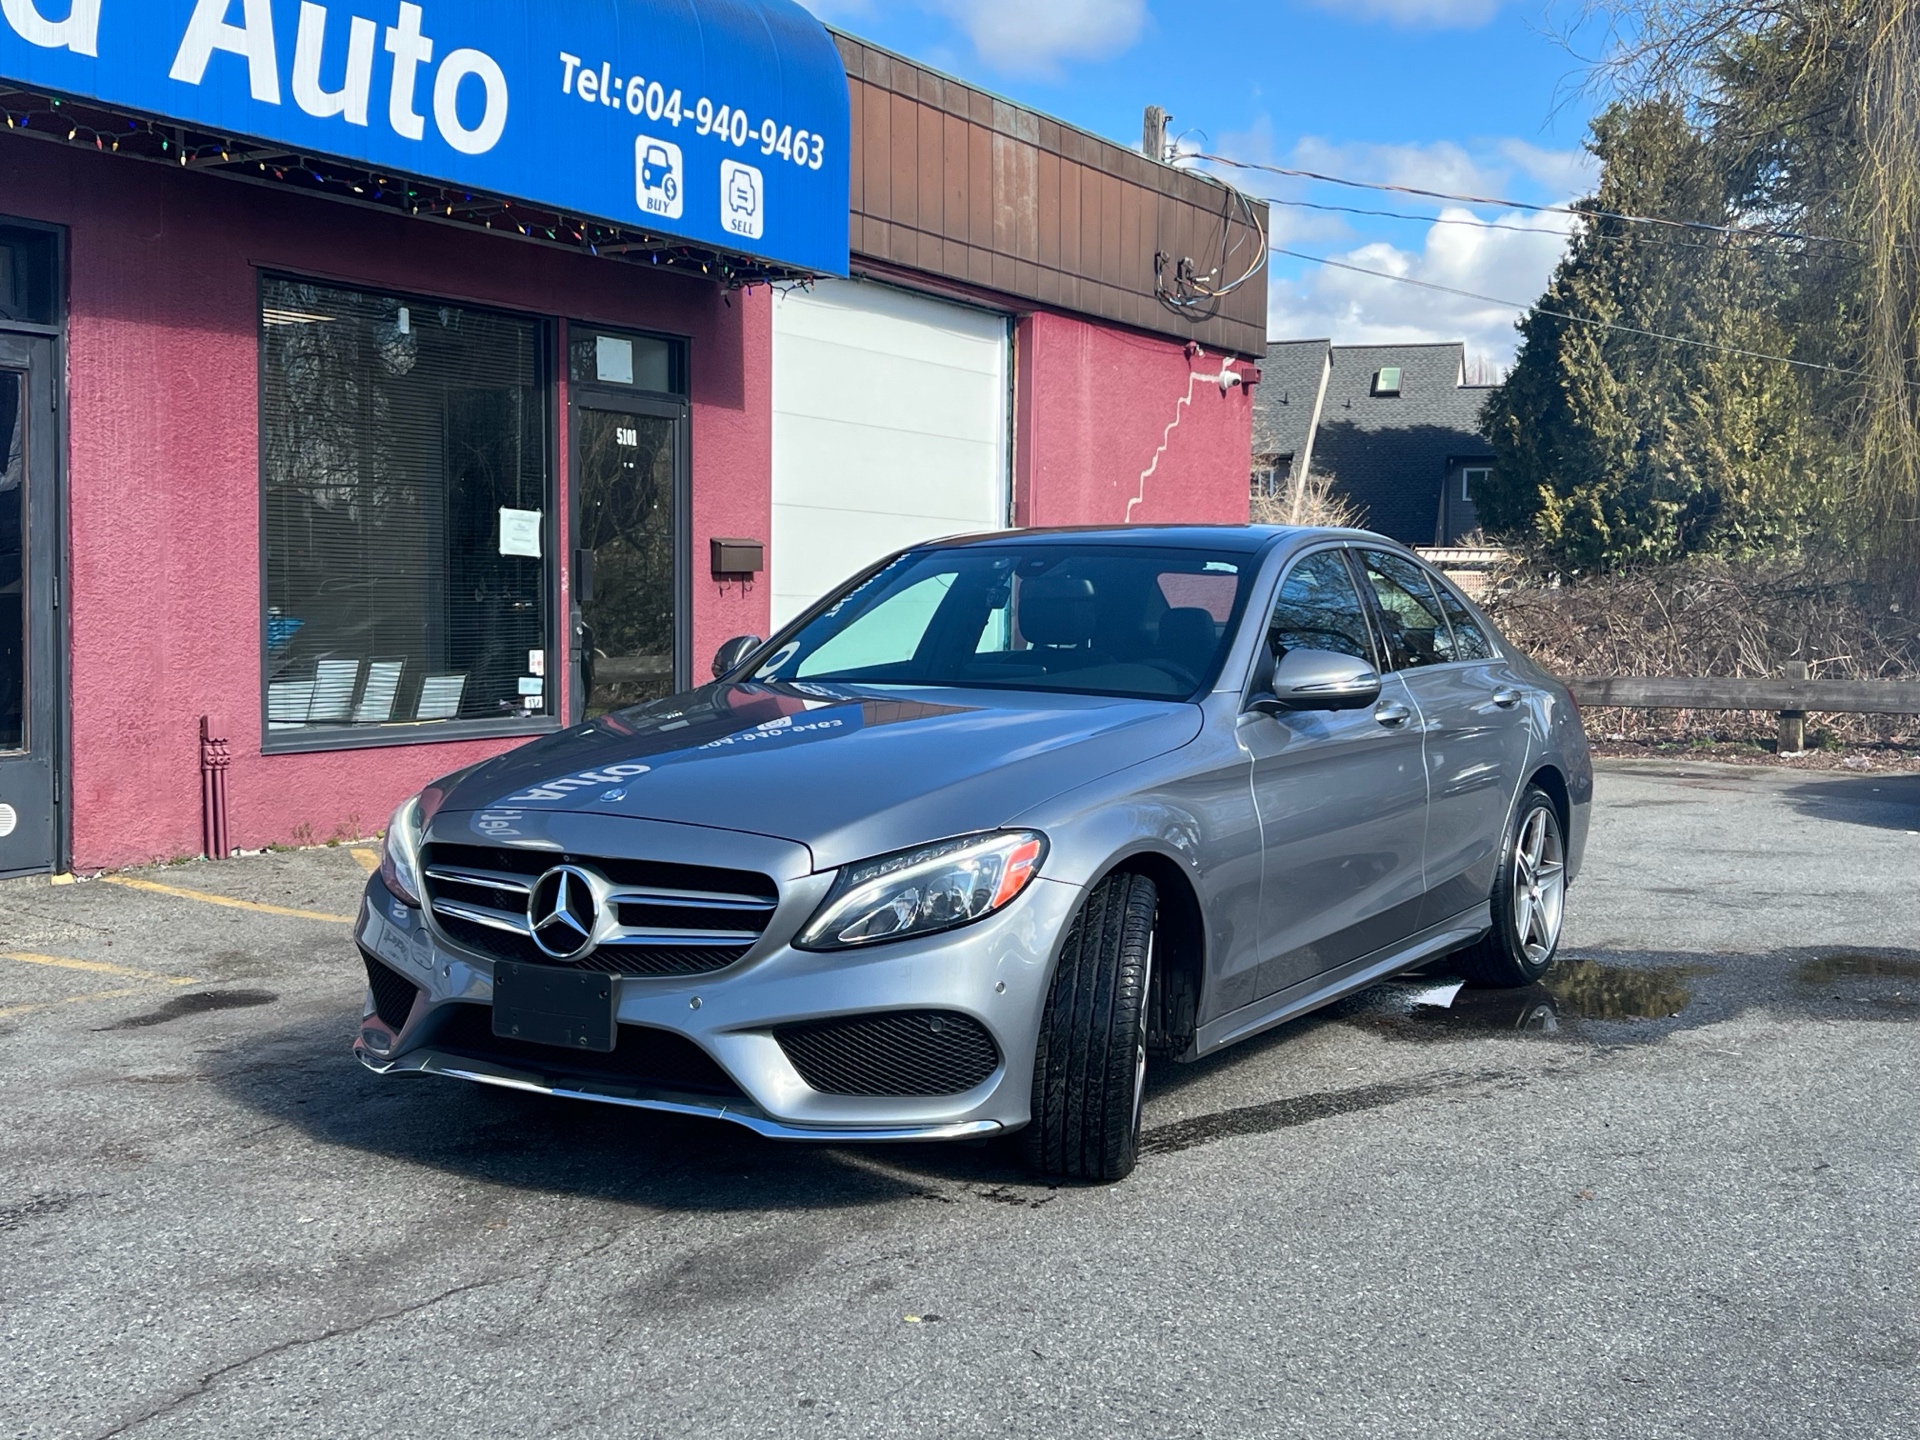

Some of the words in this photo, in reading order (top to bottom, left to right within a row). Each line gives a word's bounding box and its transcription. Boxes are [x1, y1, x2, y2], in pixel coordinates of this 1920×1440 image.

[168, 0, 509, 155] Auto
[646, 197, 671, 214] BUY
[730, 218, 754, 235] SELL
[616, 427, 638, 447] 5101
